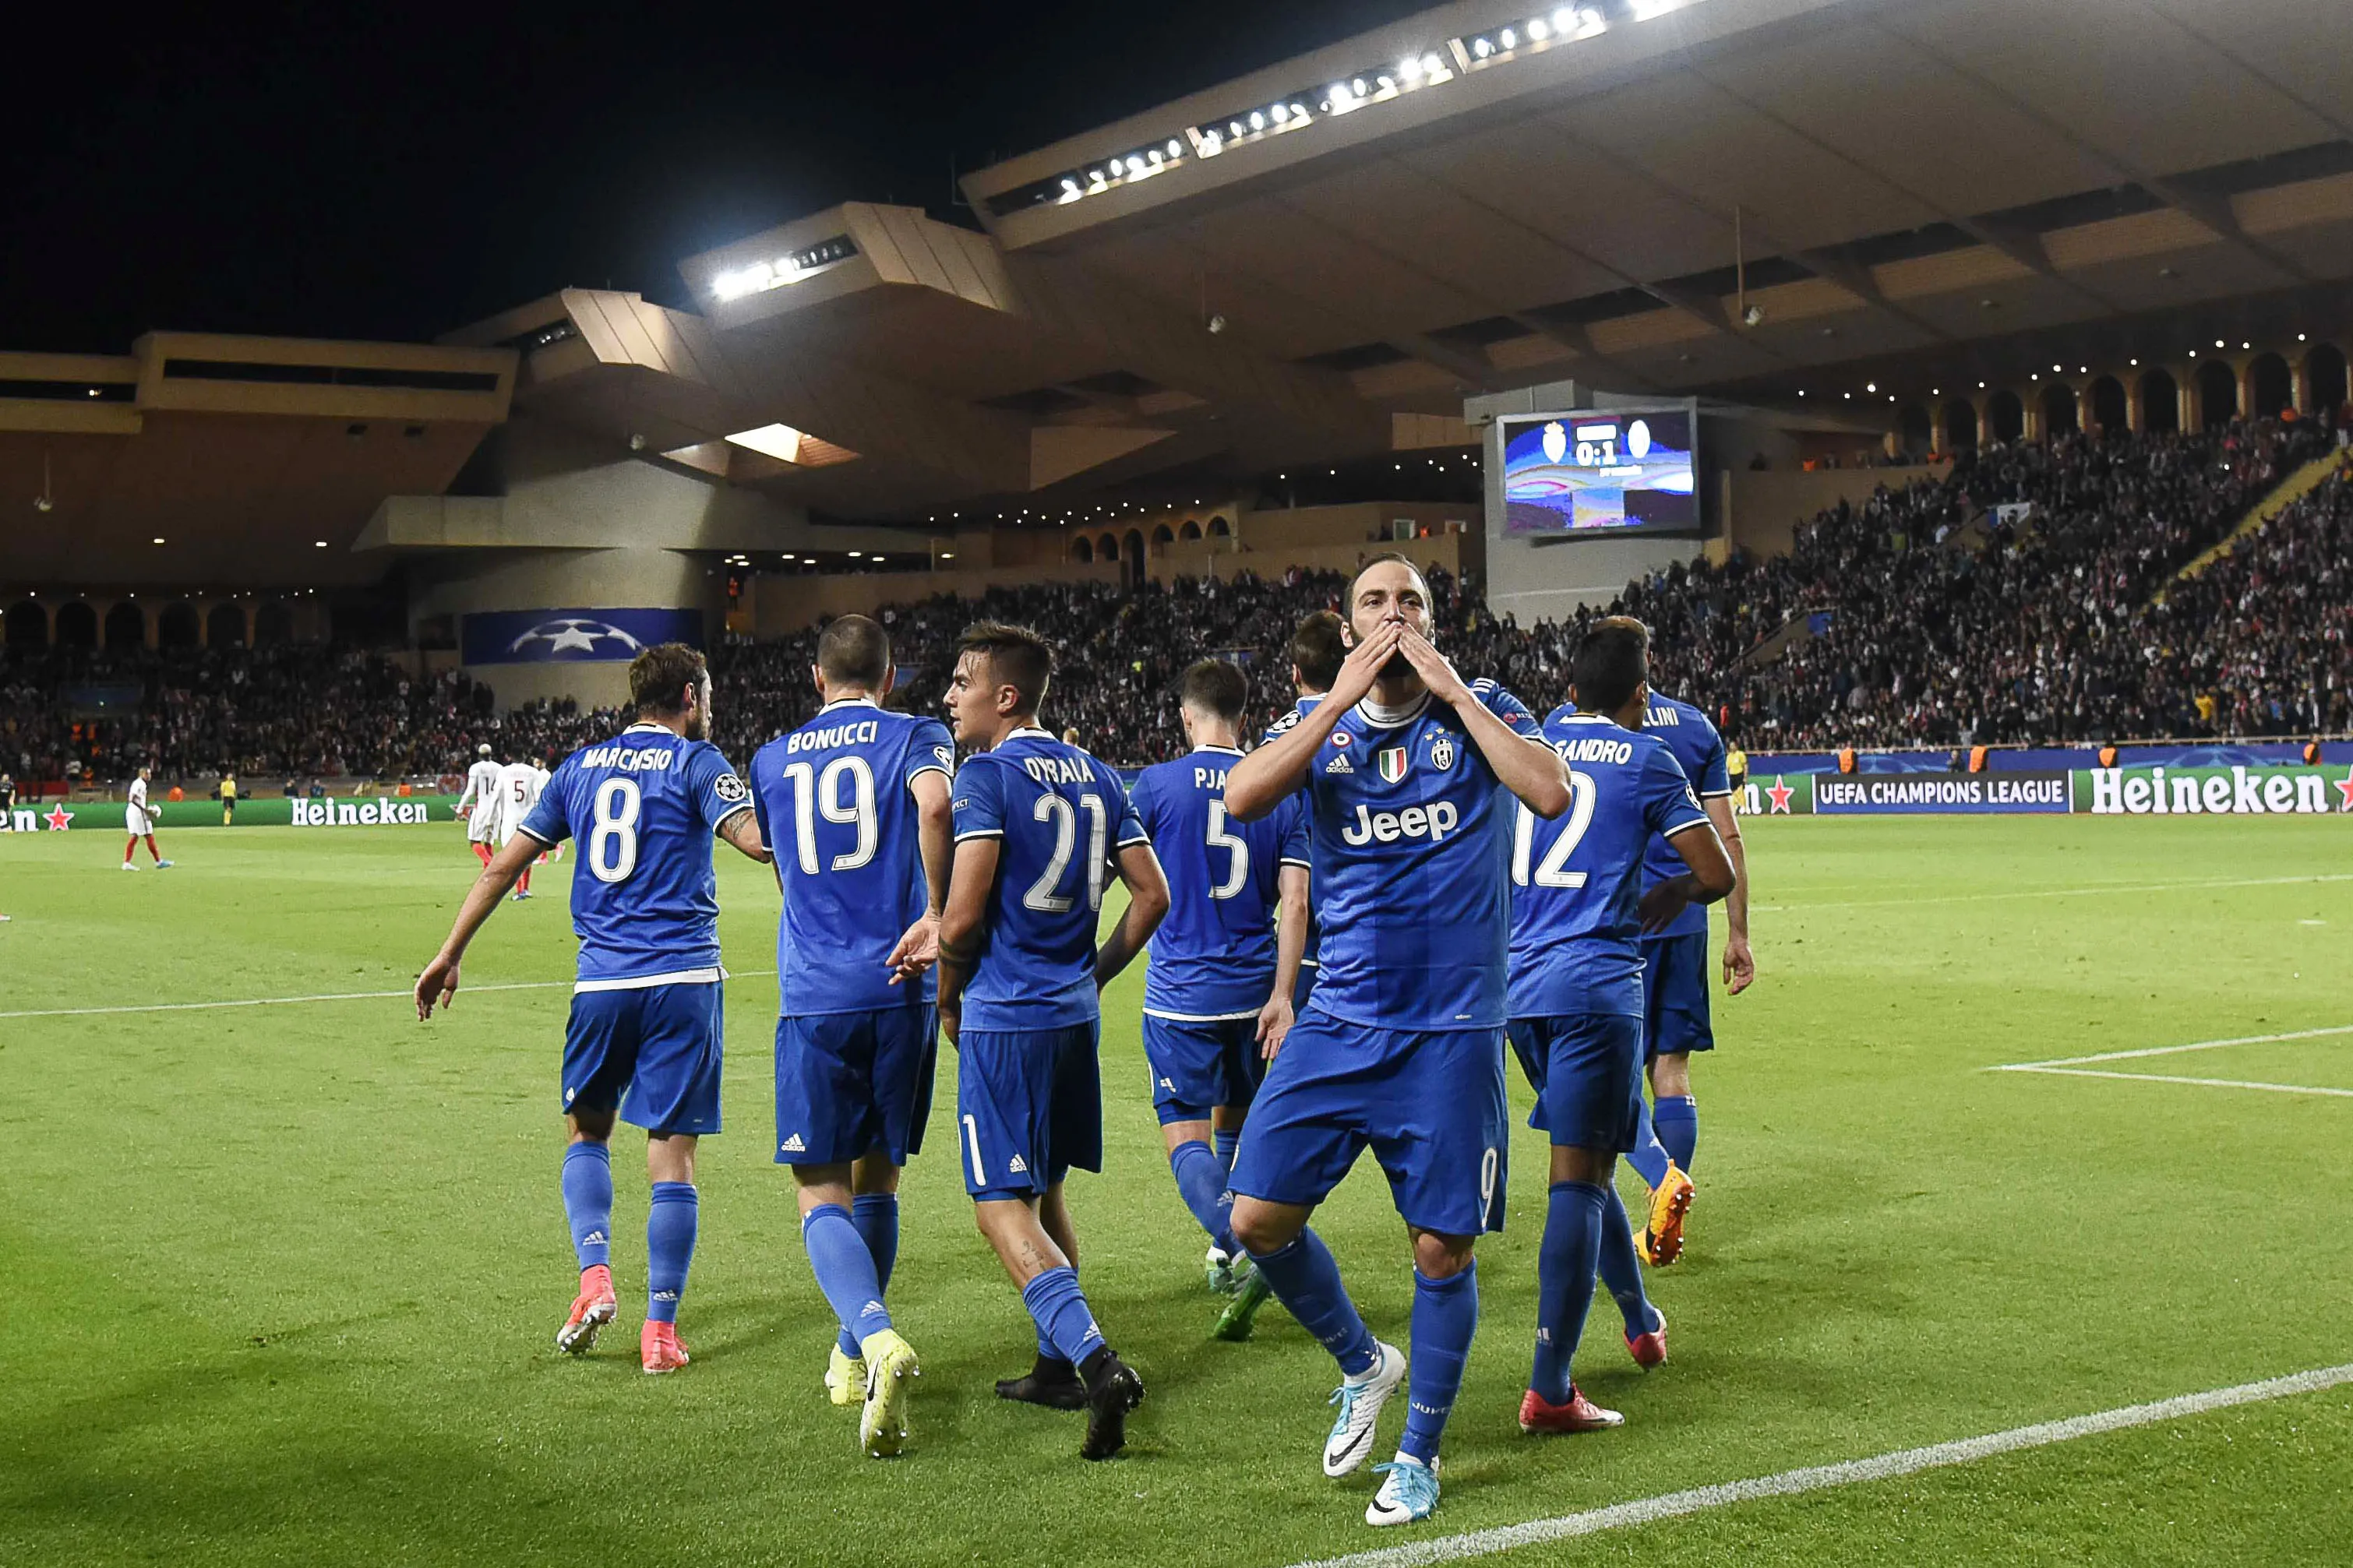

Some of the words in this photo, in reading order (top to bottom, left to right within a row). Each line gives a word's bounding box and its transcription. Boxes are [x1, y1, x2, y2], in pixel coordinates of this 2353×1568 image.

[787, 721, 878, 755] BONUCCI
[1554, 738, 1632, 765] SANDRO
[580, 748, 672, 771] MARCHSIO
[1023, 756, 1096, 784] DYBALA
[515, 780, 525, 802] 5
[1194, 767, 1226, 791] PJA
[1820, 783, 1868, 805] UEFA
[1871, 780, 1981, 804] CHAMPIONS
[1987, 780, 2064, 803] LEAGUE
[2090, 766, 2329, 813] Heineken
[291, 796, 428, 826] Heineken
[784, 756, 877, 875] 19
[1342, 801, 1459, 846] Jeep
[589, 778, 640, 883] 8
[1512, 770, 1596, 888] 12
[1023, 792, 1106, 913] 21
[1208, 798, 1249, 900] 5
